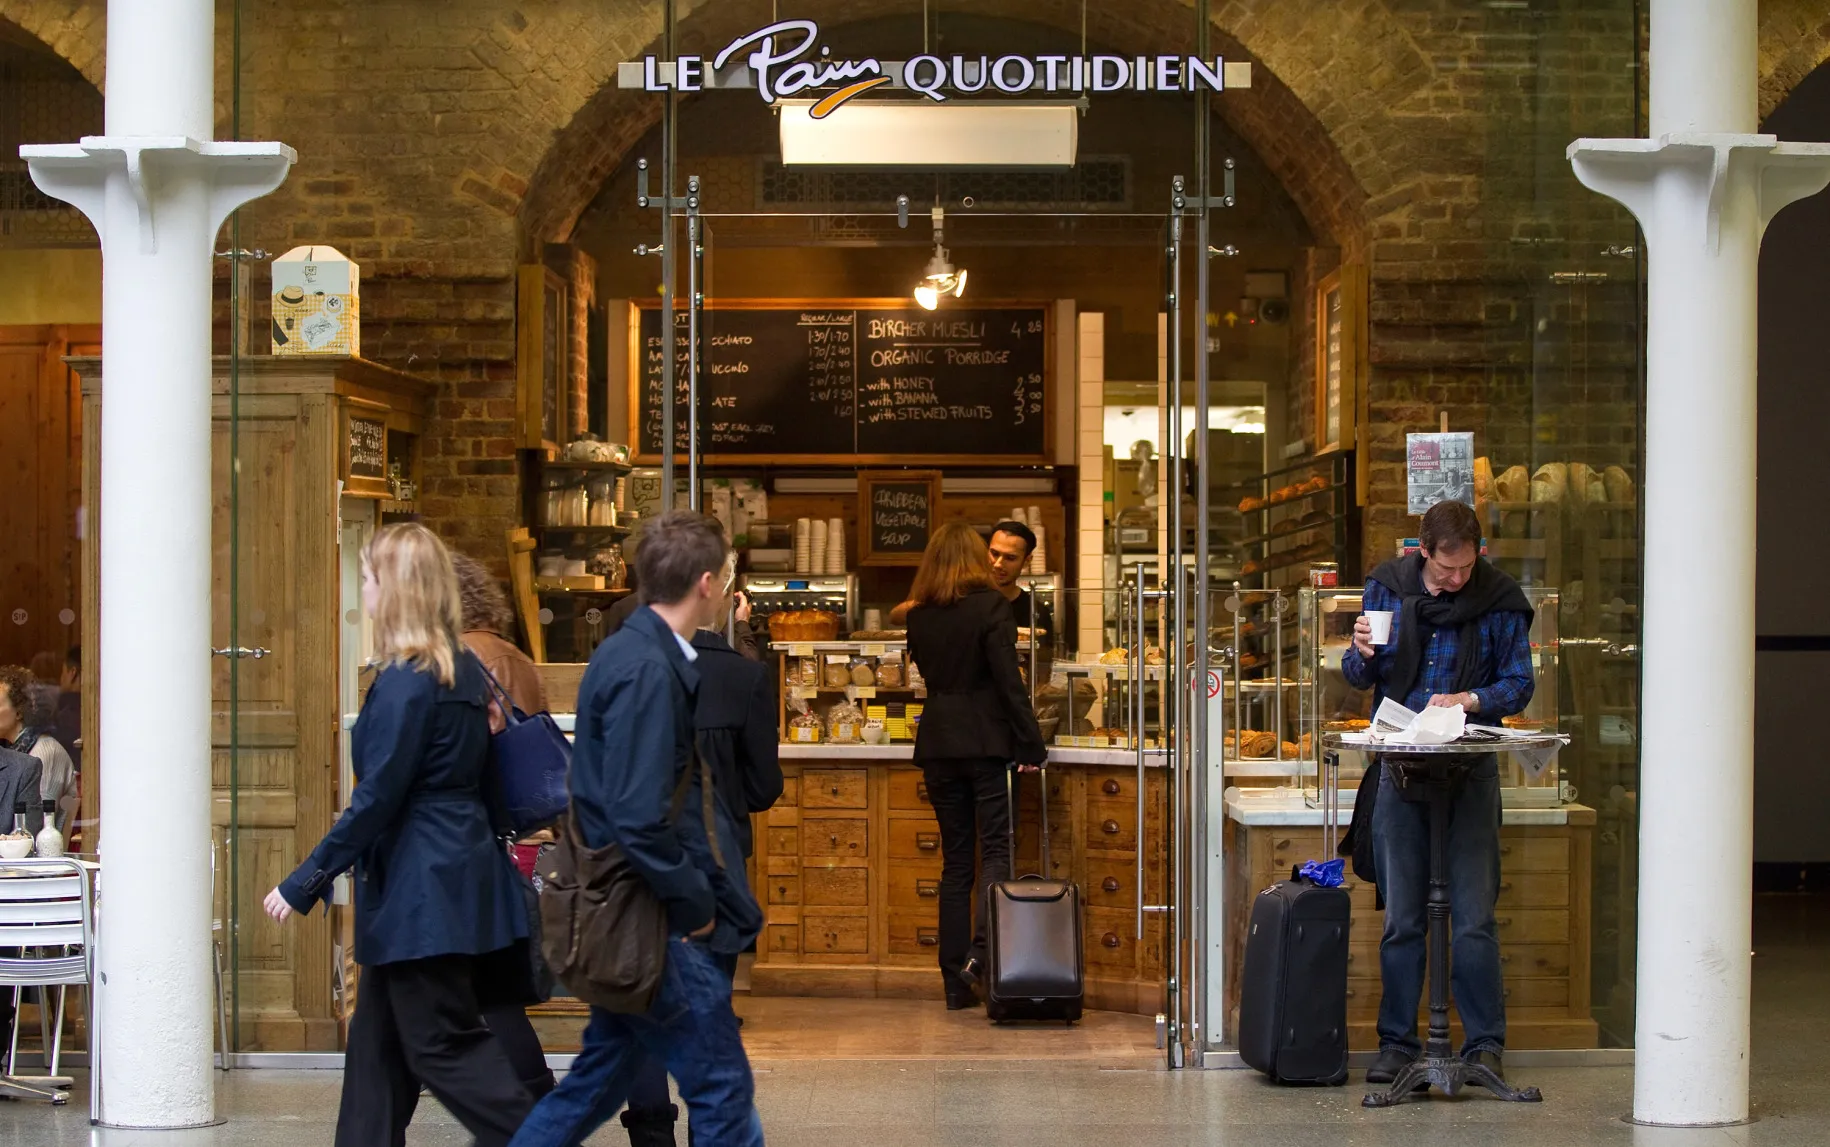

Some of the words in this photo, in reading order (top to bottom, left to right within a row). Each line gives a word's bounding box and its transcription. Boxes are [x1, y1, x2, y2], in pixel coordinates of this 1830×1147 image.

[643, 54, 703, 94] LE
[711, 18, 882, 103] Pain
[902, 53, 1227, 103] QUOTIDIEN
[932, 321, 985, 338] MUESLI
[871, 350, 935, 368] ORGANIC
[945, 349, 1011, 365] PORRIDGE
[866, 377, 891, 392] with
[894, 377, 936, 392] HONEY
[868, 394, 893, 407] with
[894, 391, 940, 405] BANANA
[869, 408, 897, 423] with
[897, 407, 948, 420] STEWED
